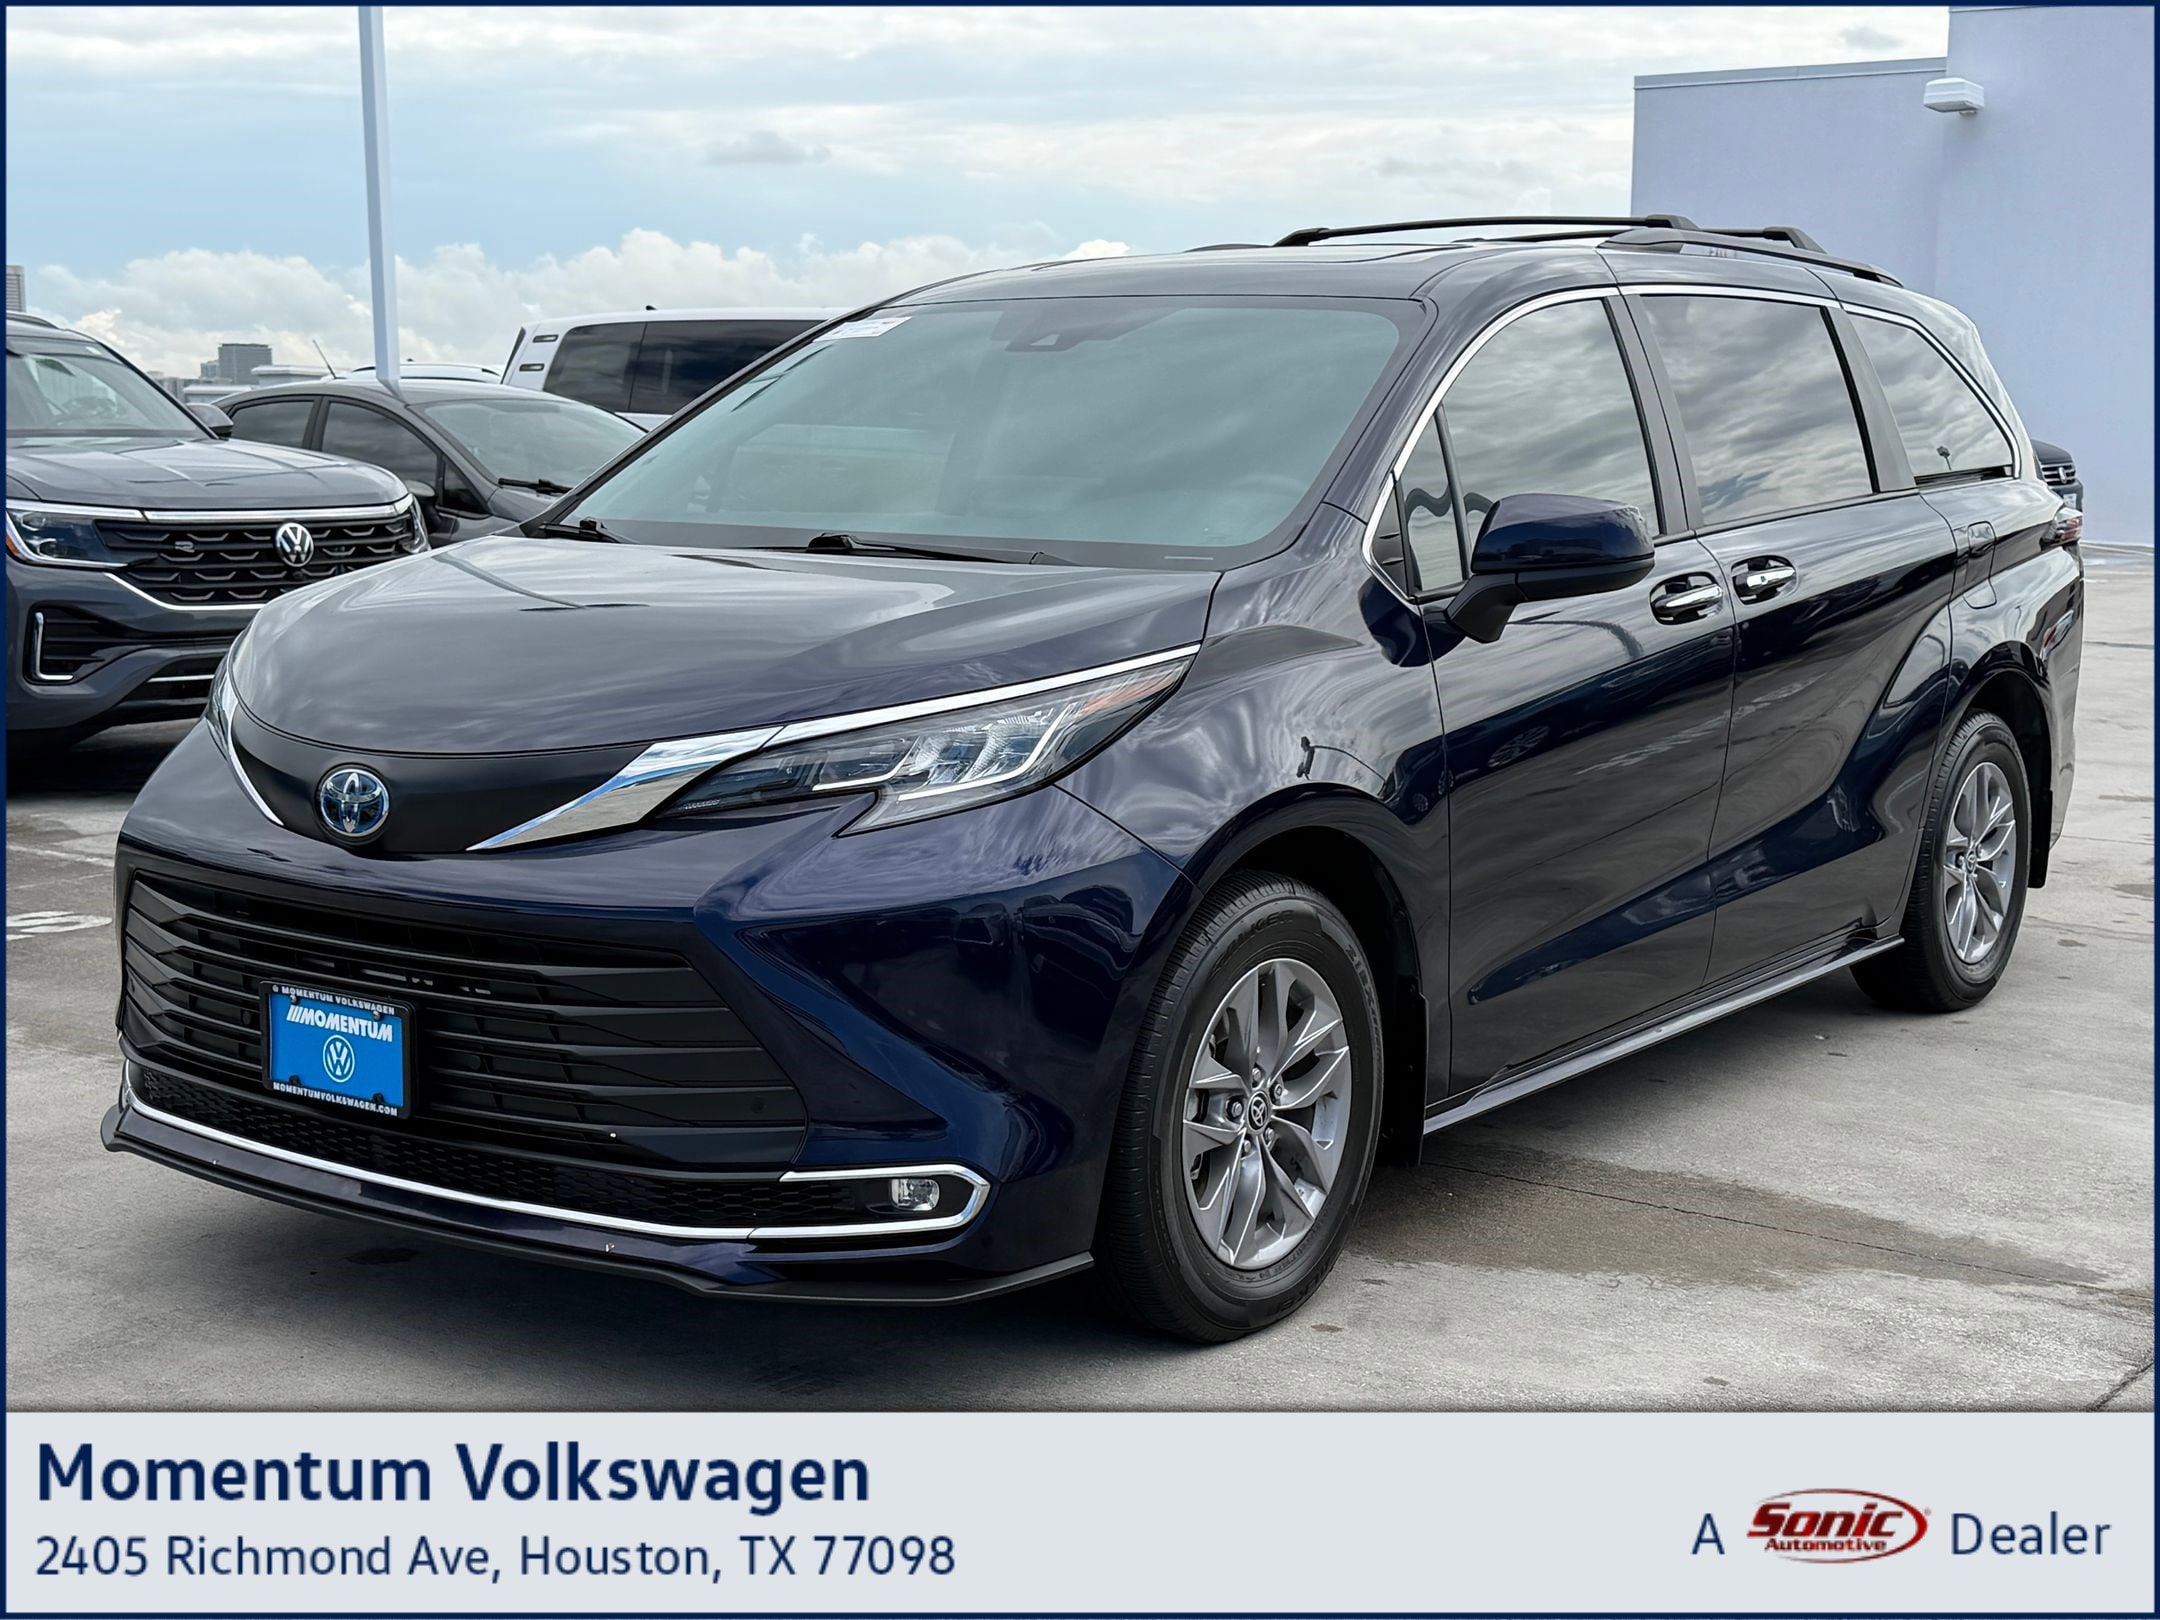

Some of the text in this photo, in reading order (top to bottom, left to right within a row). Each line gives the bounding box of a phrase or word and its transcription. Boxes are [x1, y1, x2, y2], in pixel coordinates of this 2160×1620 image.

[281, 986, 395, 1015] MOMENTUM VOLKSWAGEN
[273, 1082, 398, 1117] MOMENTUMVOLKSWAGEN.COM
